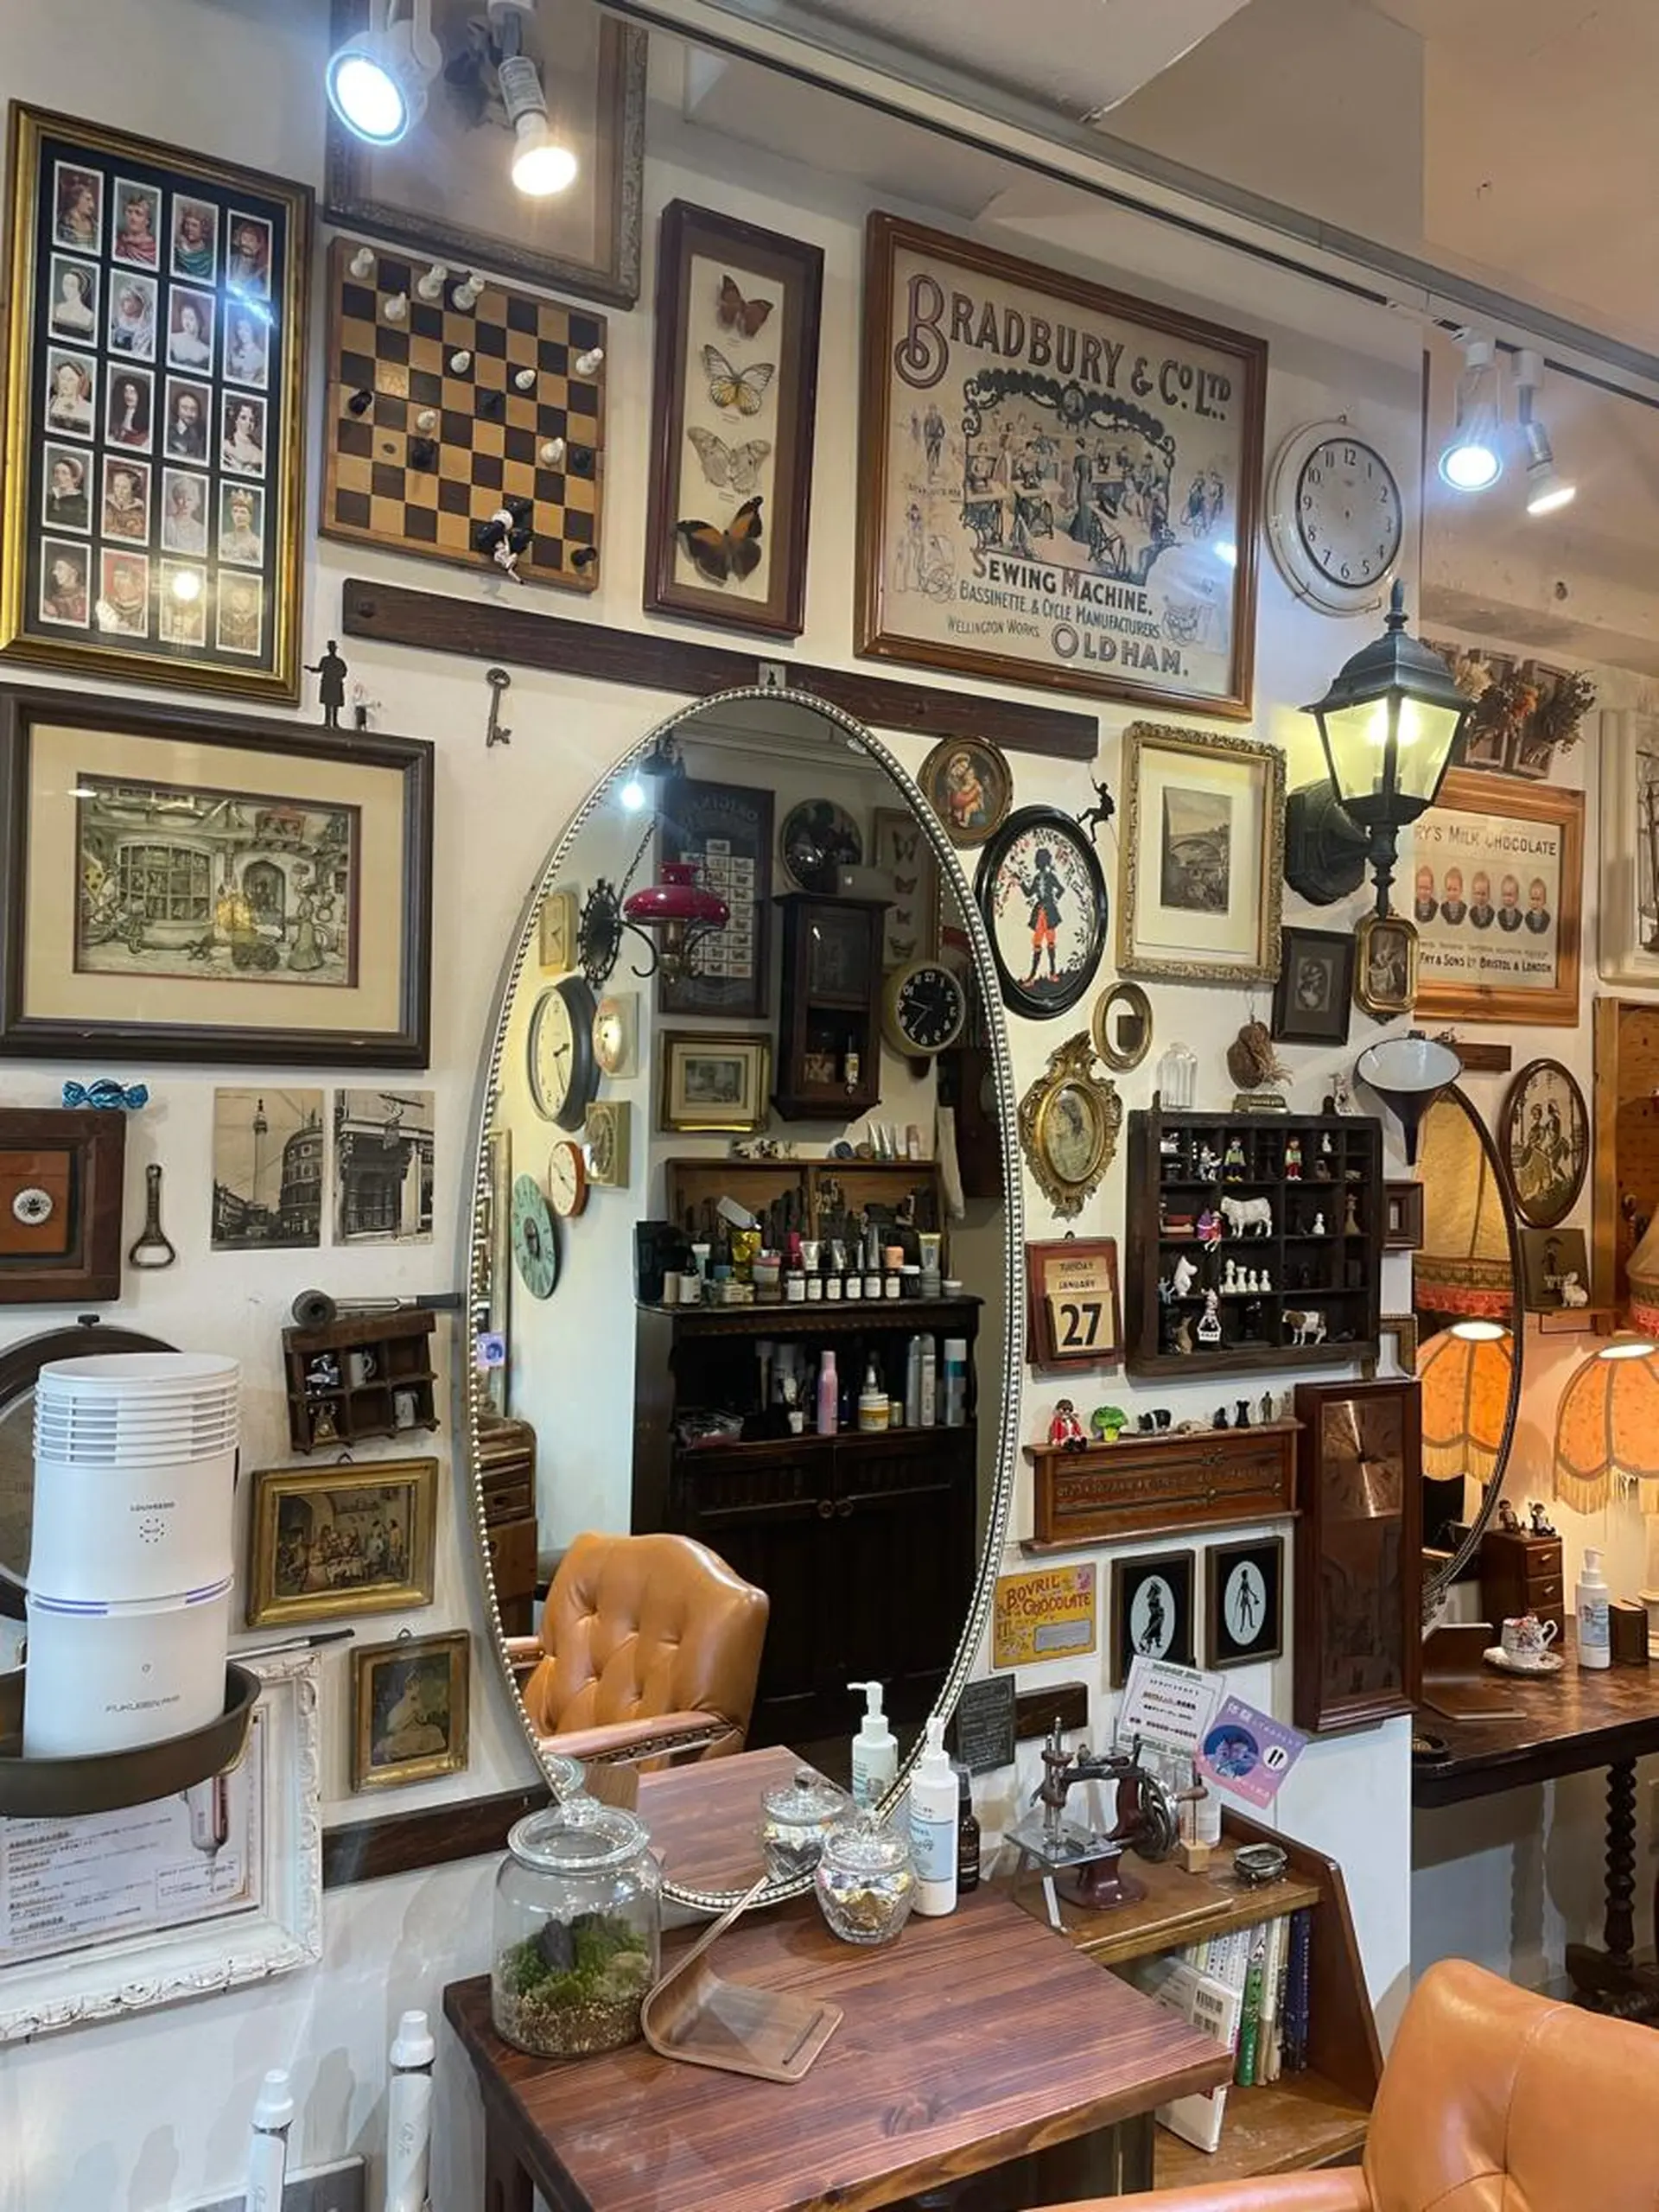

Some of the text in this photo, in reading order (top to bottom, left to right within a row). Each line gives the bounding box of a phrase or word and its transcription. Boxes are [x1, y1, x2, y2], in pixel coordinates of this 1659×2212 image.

[893, 273, 1125, 391] BRADBURY
[1130, 357, 1154, 397] &
[1325, 451, 1335, 468] 11
[1344, 448, 1357, 467] 12
[1307, 467, 1321, 484] 10
[1367, 462, 1372, 478] 1
[1302, 494, 1313, 511] 9
[1381, 486, 1388, 503] 2
[1307, 524, 1316, 542] 8
[1323, 549, 1332, 565] 7
[971, 547, 1056, 594] SEWING
[1340, 563, 1350, 579] 6
[1362, 560, 1370, 575] 5
[959, 580, 1025, 613] BASSINETTE
[1031, 600, 1039, 614] &
[1060, 1303, 1103, 1346] 27
